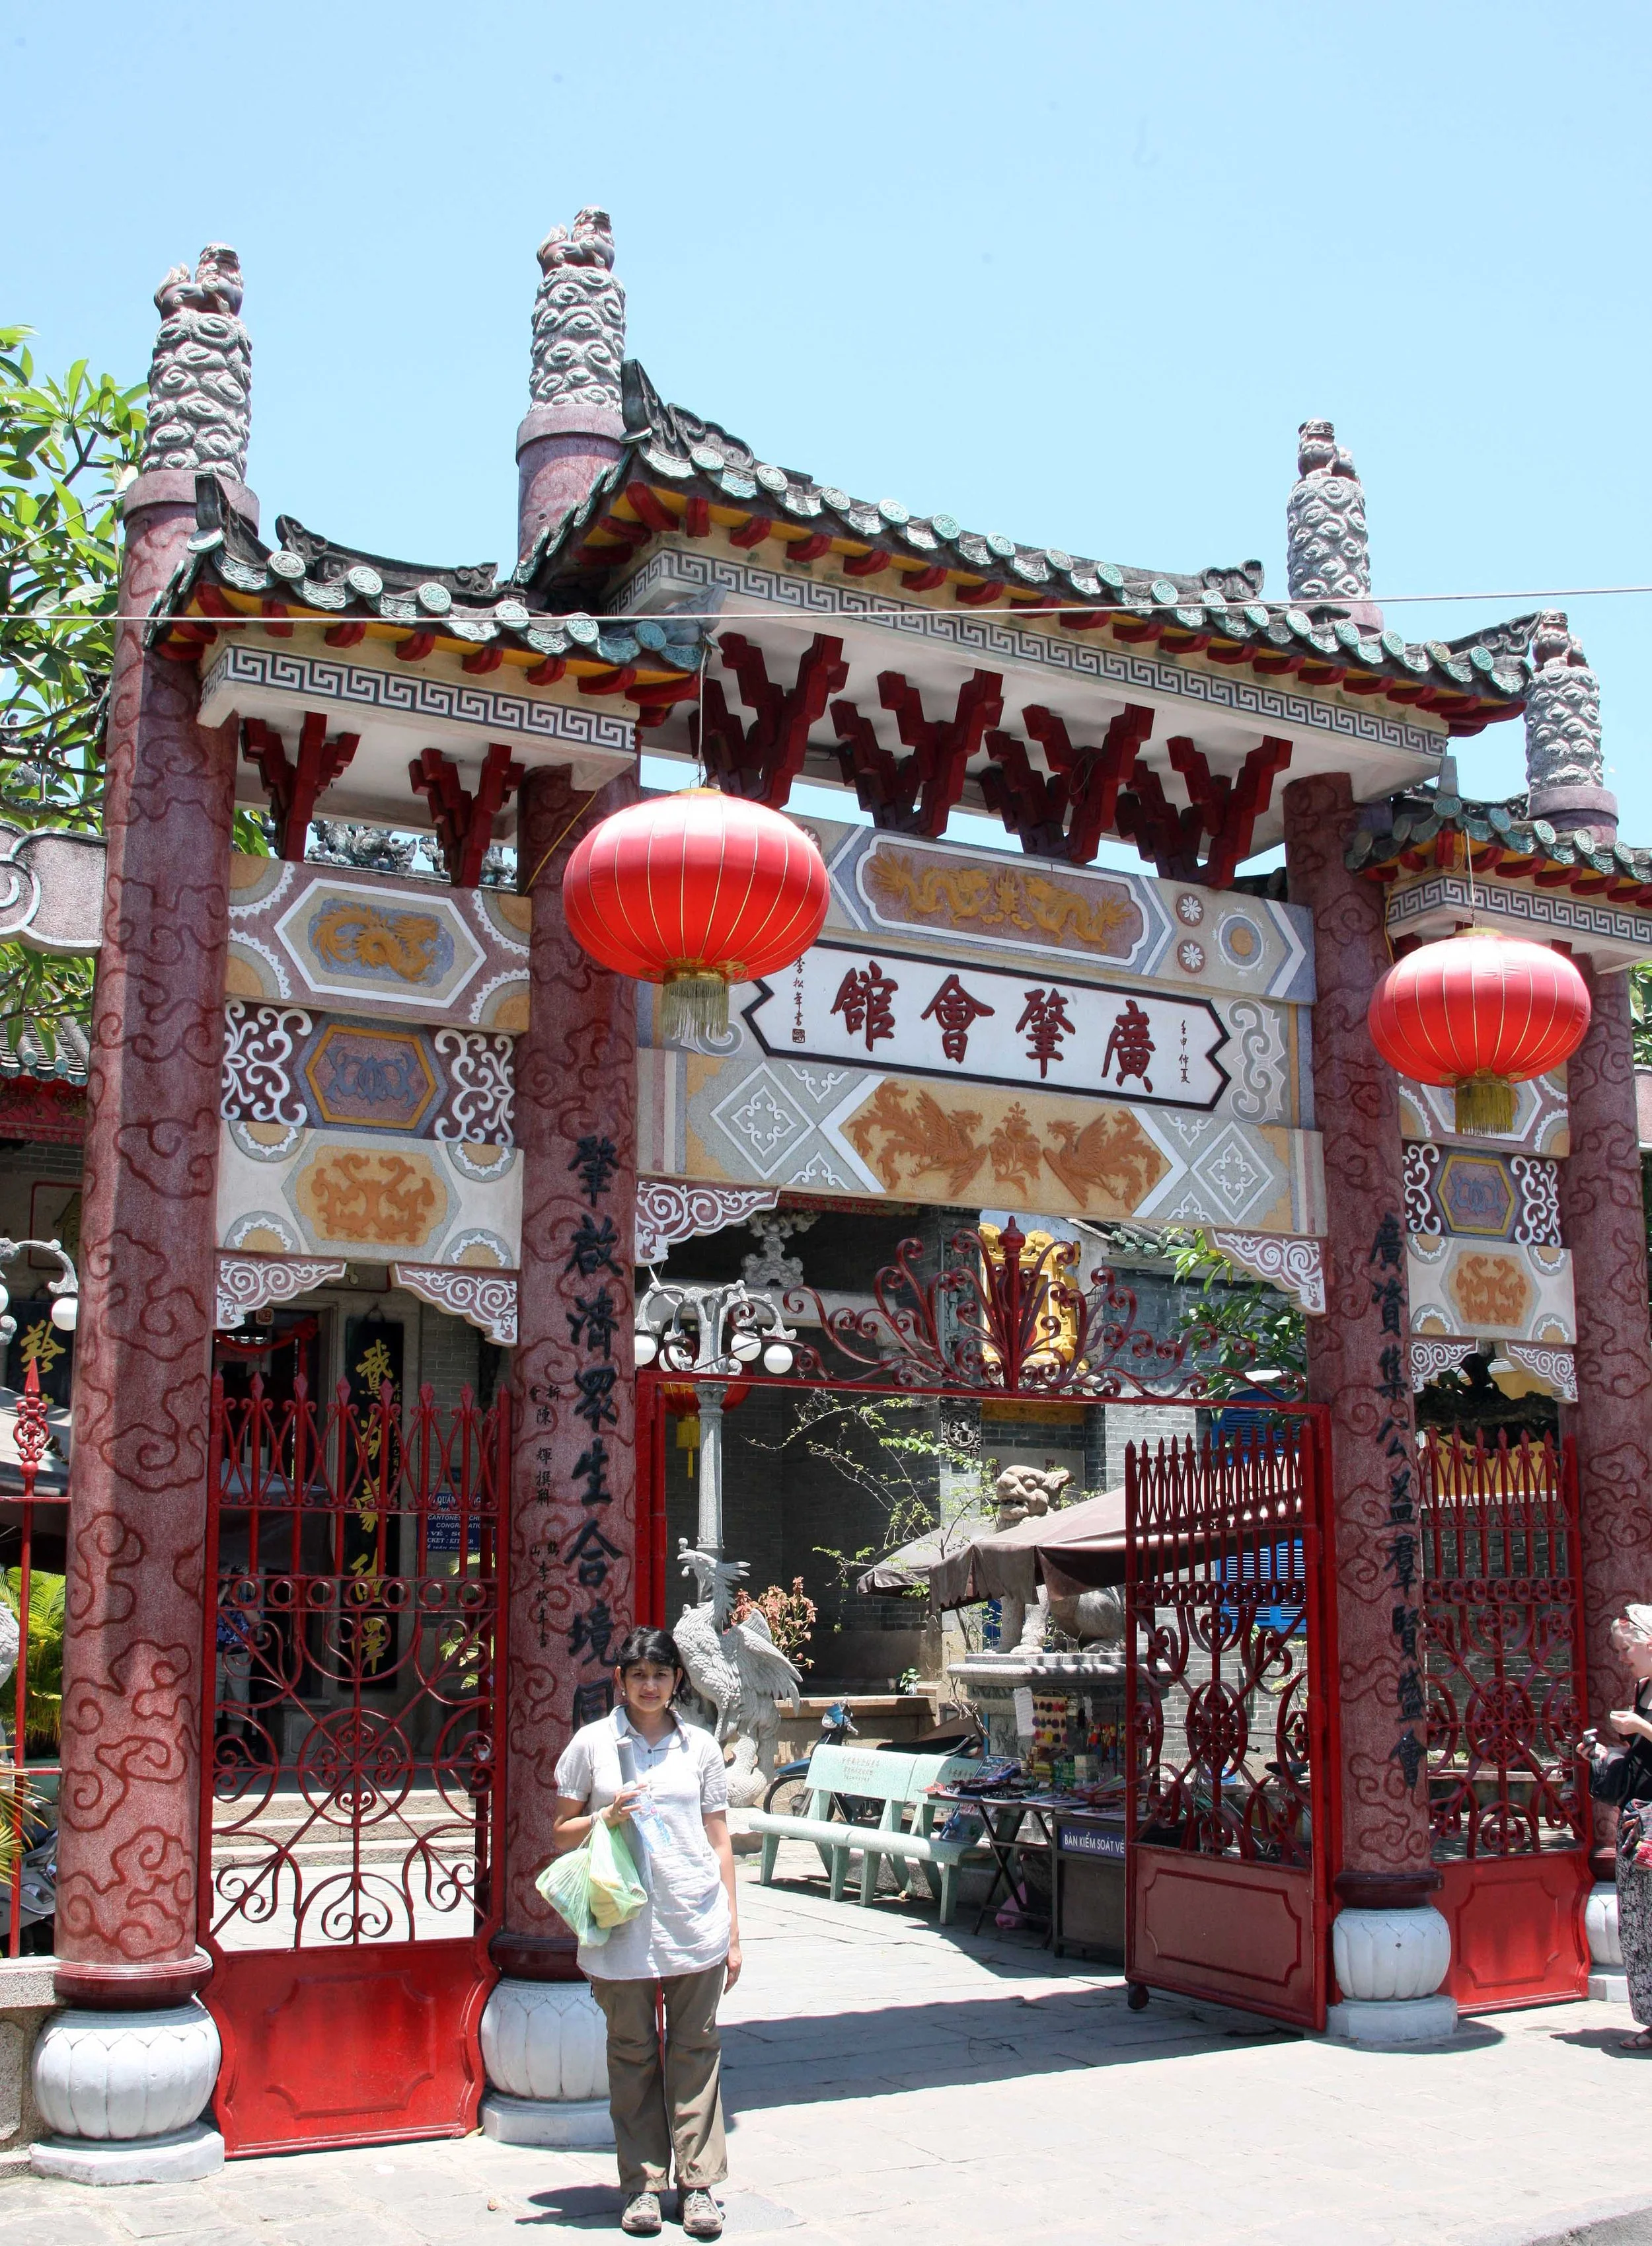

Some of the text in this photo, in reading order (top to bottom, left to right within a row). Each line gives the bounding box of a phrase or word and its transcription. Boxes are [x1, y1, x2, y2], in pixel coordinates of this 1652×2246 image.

[829, 959, 1156, 1094] 廣肇會館
[1065, 1831, 1078, 1847] BÀN
[1079, 1831, 1096, 1849] KIỂM
[1097, 1836, 1113, 1852] SOÁT
